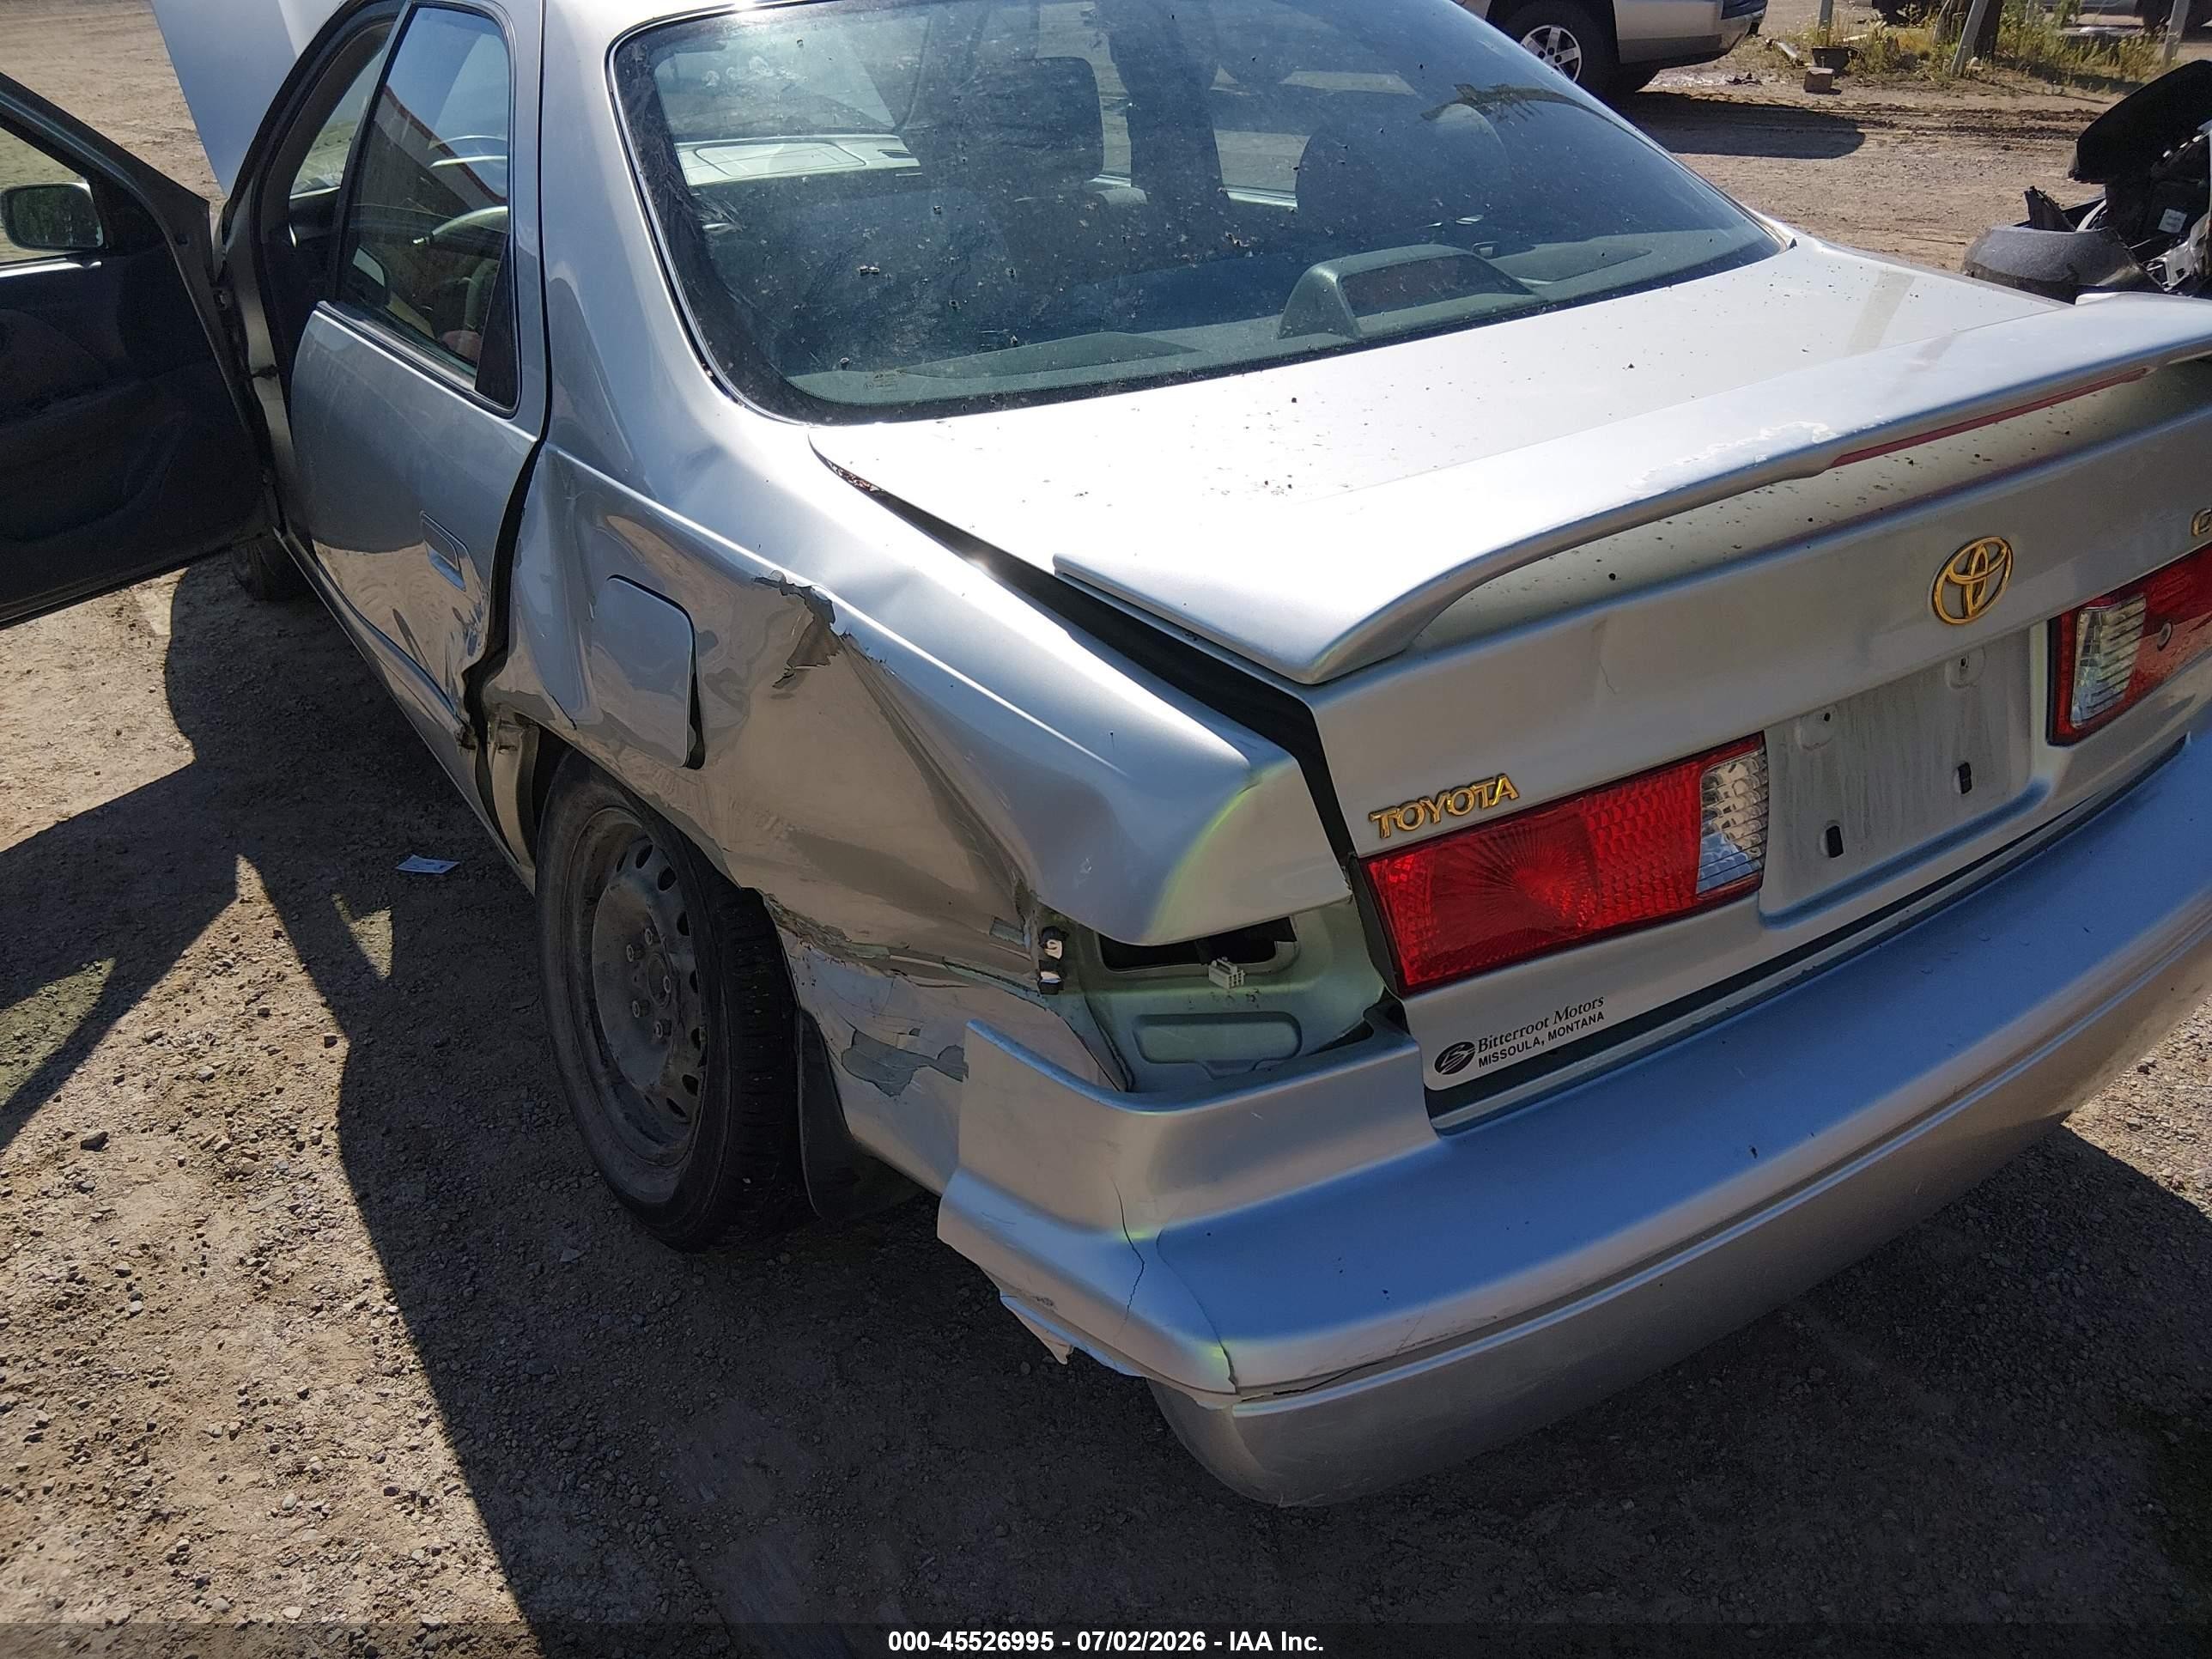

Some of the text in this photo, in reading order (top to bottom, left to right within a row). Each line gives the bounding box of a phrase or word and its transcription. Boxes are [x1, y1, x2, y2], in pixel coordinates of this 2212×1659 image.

[1369, 773, 1520, 839] TOYOTA
[1478, 996, 1605, 1054] Bitterroot Motors
[1478, 1011, 1605, 1068] MISSOULA, MONTANA
